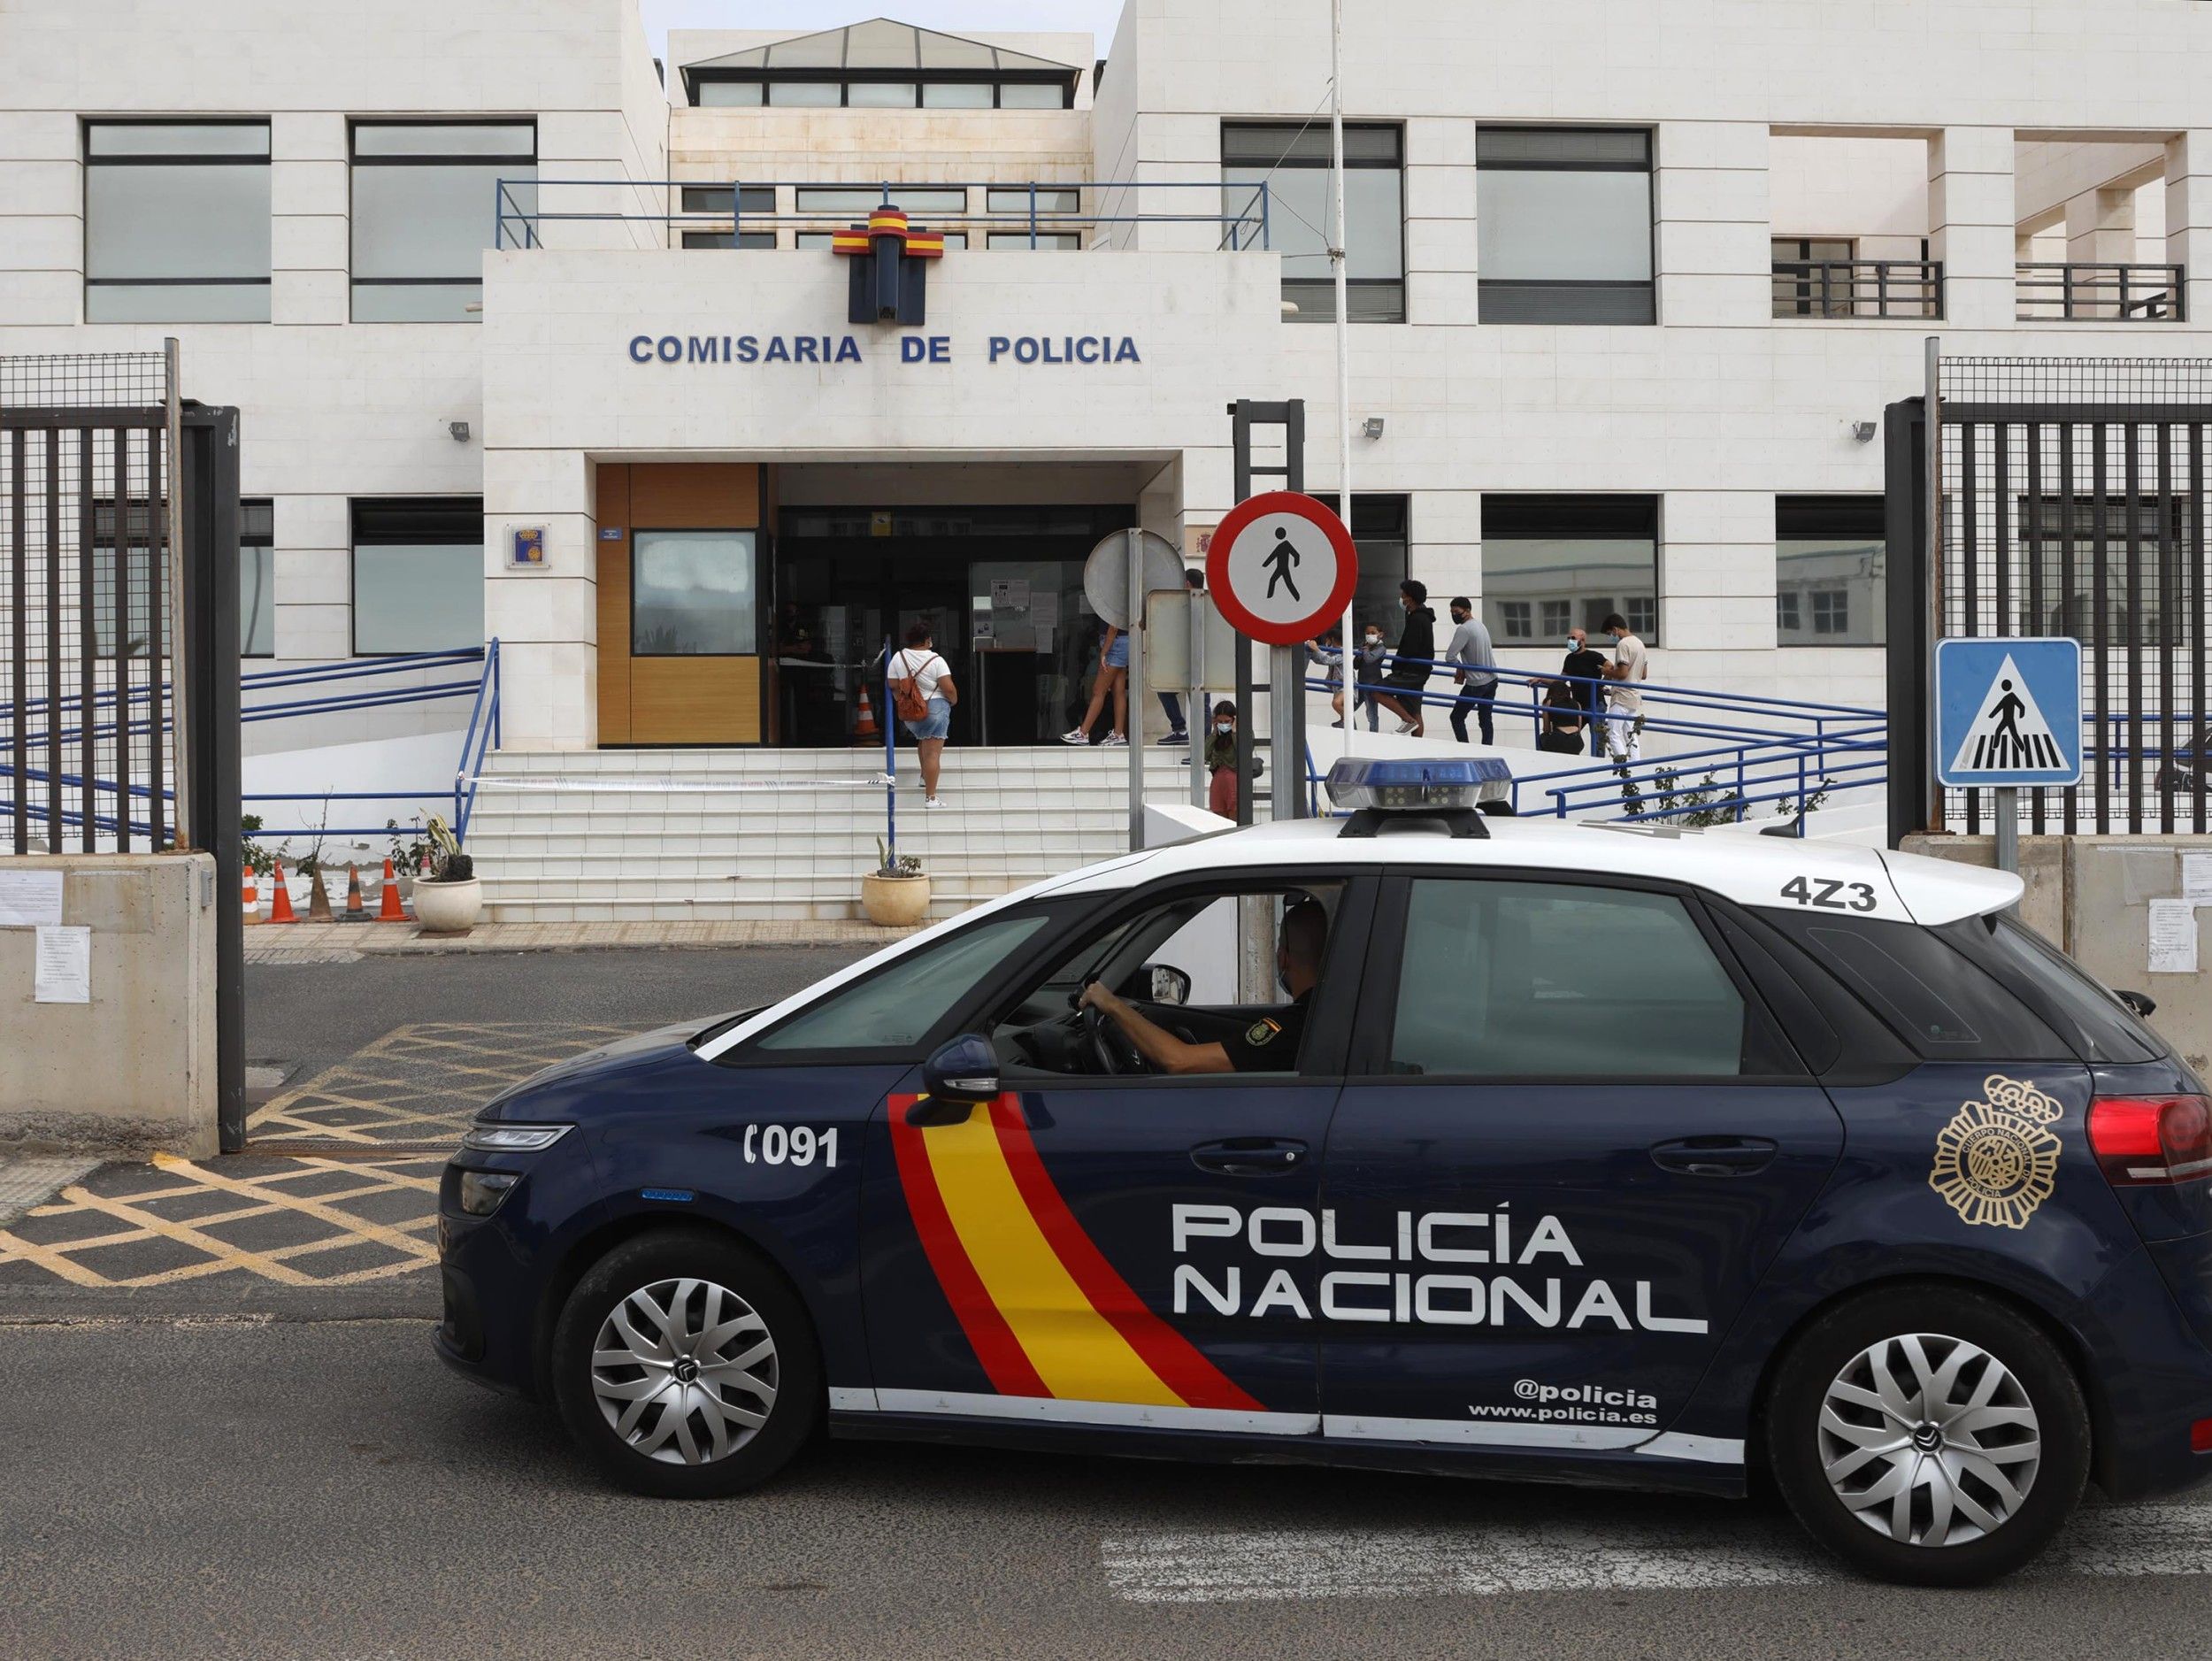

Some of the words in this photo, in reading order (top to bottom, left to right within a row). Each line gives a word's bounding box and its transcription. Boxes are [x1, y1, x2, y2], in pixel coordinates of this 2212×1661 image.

[629, 335, 863, 364] COMISARIA
[901, 335, 951, 364] DE
[989, 335, 1141, 364] POLICIA
[1780, 875, 1877, 912] 4Z3
[762, 1124, 838, 1168] 091
[1962, 1128, 1995, 1153] CUERPO
[1997, 1128, 2032, 1166] NACIONAL
[1966, 1176, 2001, 1198] POLICIA
[1172, 1201, 1584, 1266] POLICÍA
[1173, 1264, 1709, 1334] NACIONAL
[1513, 1379, 1657, 1410] @policia
[1468, 1404, 1657, 1425] www.policia.es
